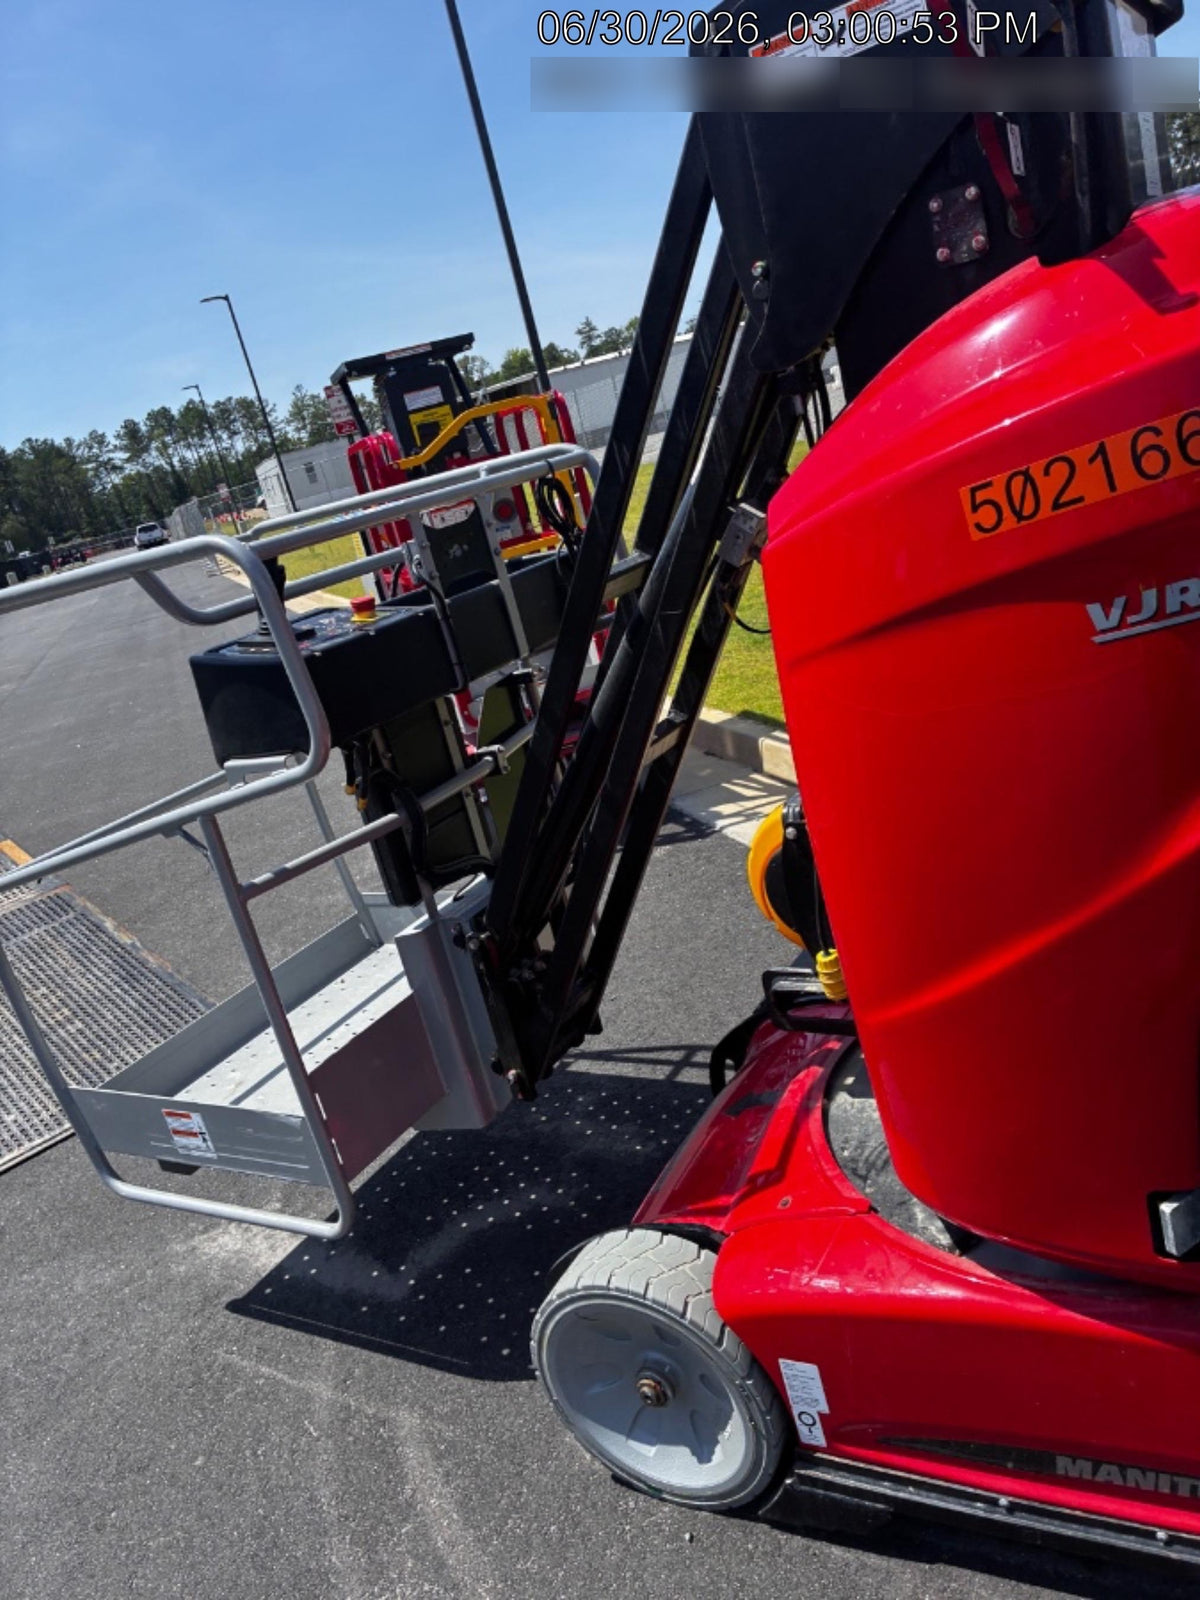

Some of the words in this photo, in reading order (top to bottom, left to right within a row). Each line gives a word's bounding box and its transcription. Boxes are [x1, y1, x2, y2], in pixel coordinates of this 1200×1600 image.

[969, 410, 1200, 535] 502166
[1085, 577, 1200, 632] VJR
[1055, 1455, 1200, 1498] MANIT
